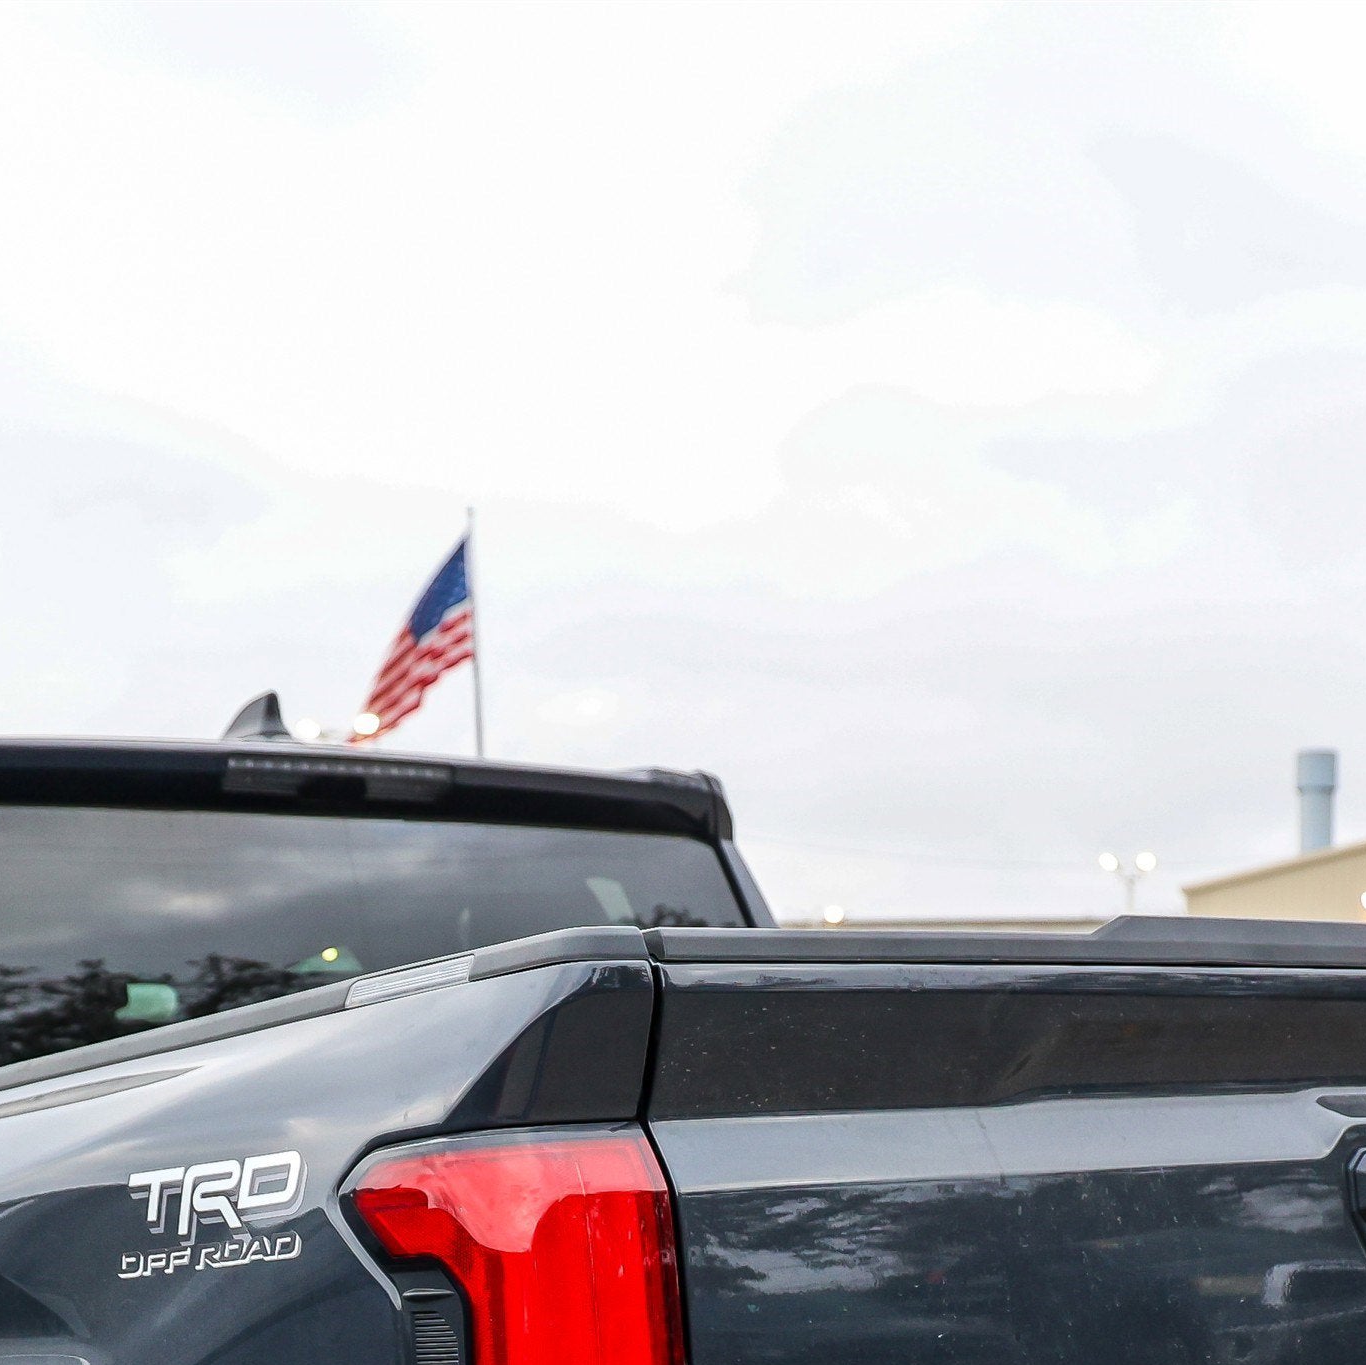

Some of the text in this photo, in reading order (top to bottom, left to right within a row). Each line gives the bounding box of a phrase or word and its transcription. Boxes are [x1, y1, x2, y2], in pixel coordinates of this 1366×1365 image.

[128, 1150, 308, 1245] TRD
[117, 1230, 303, 1280] OFF ROAD
